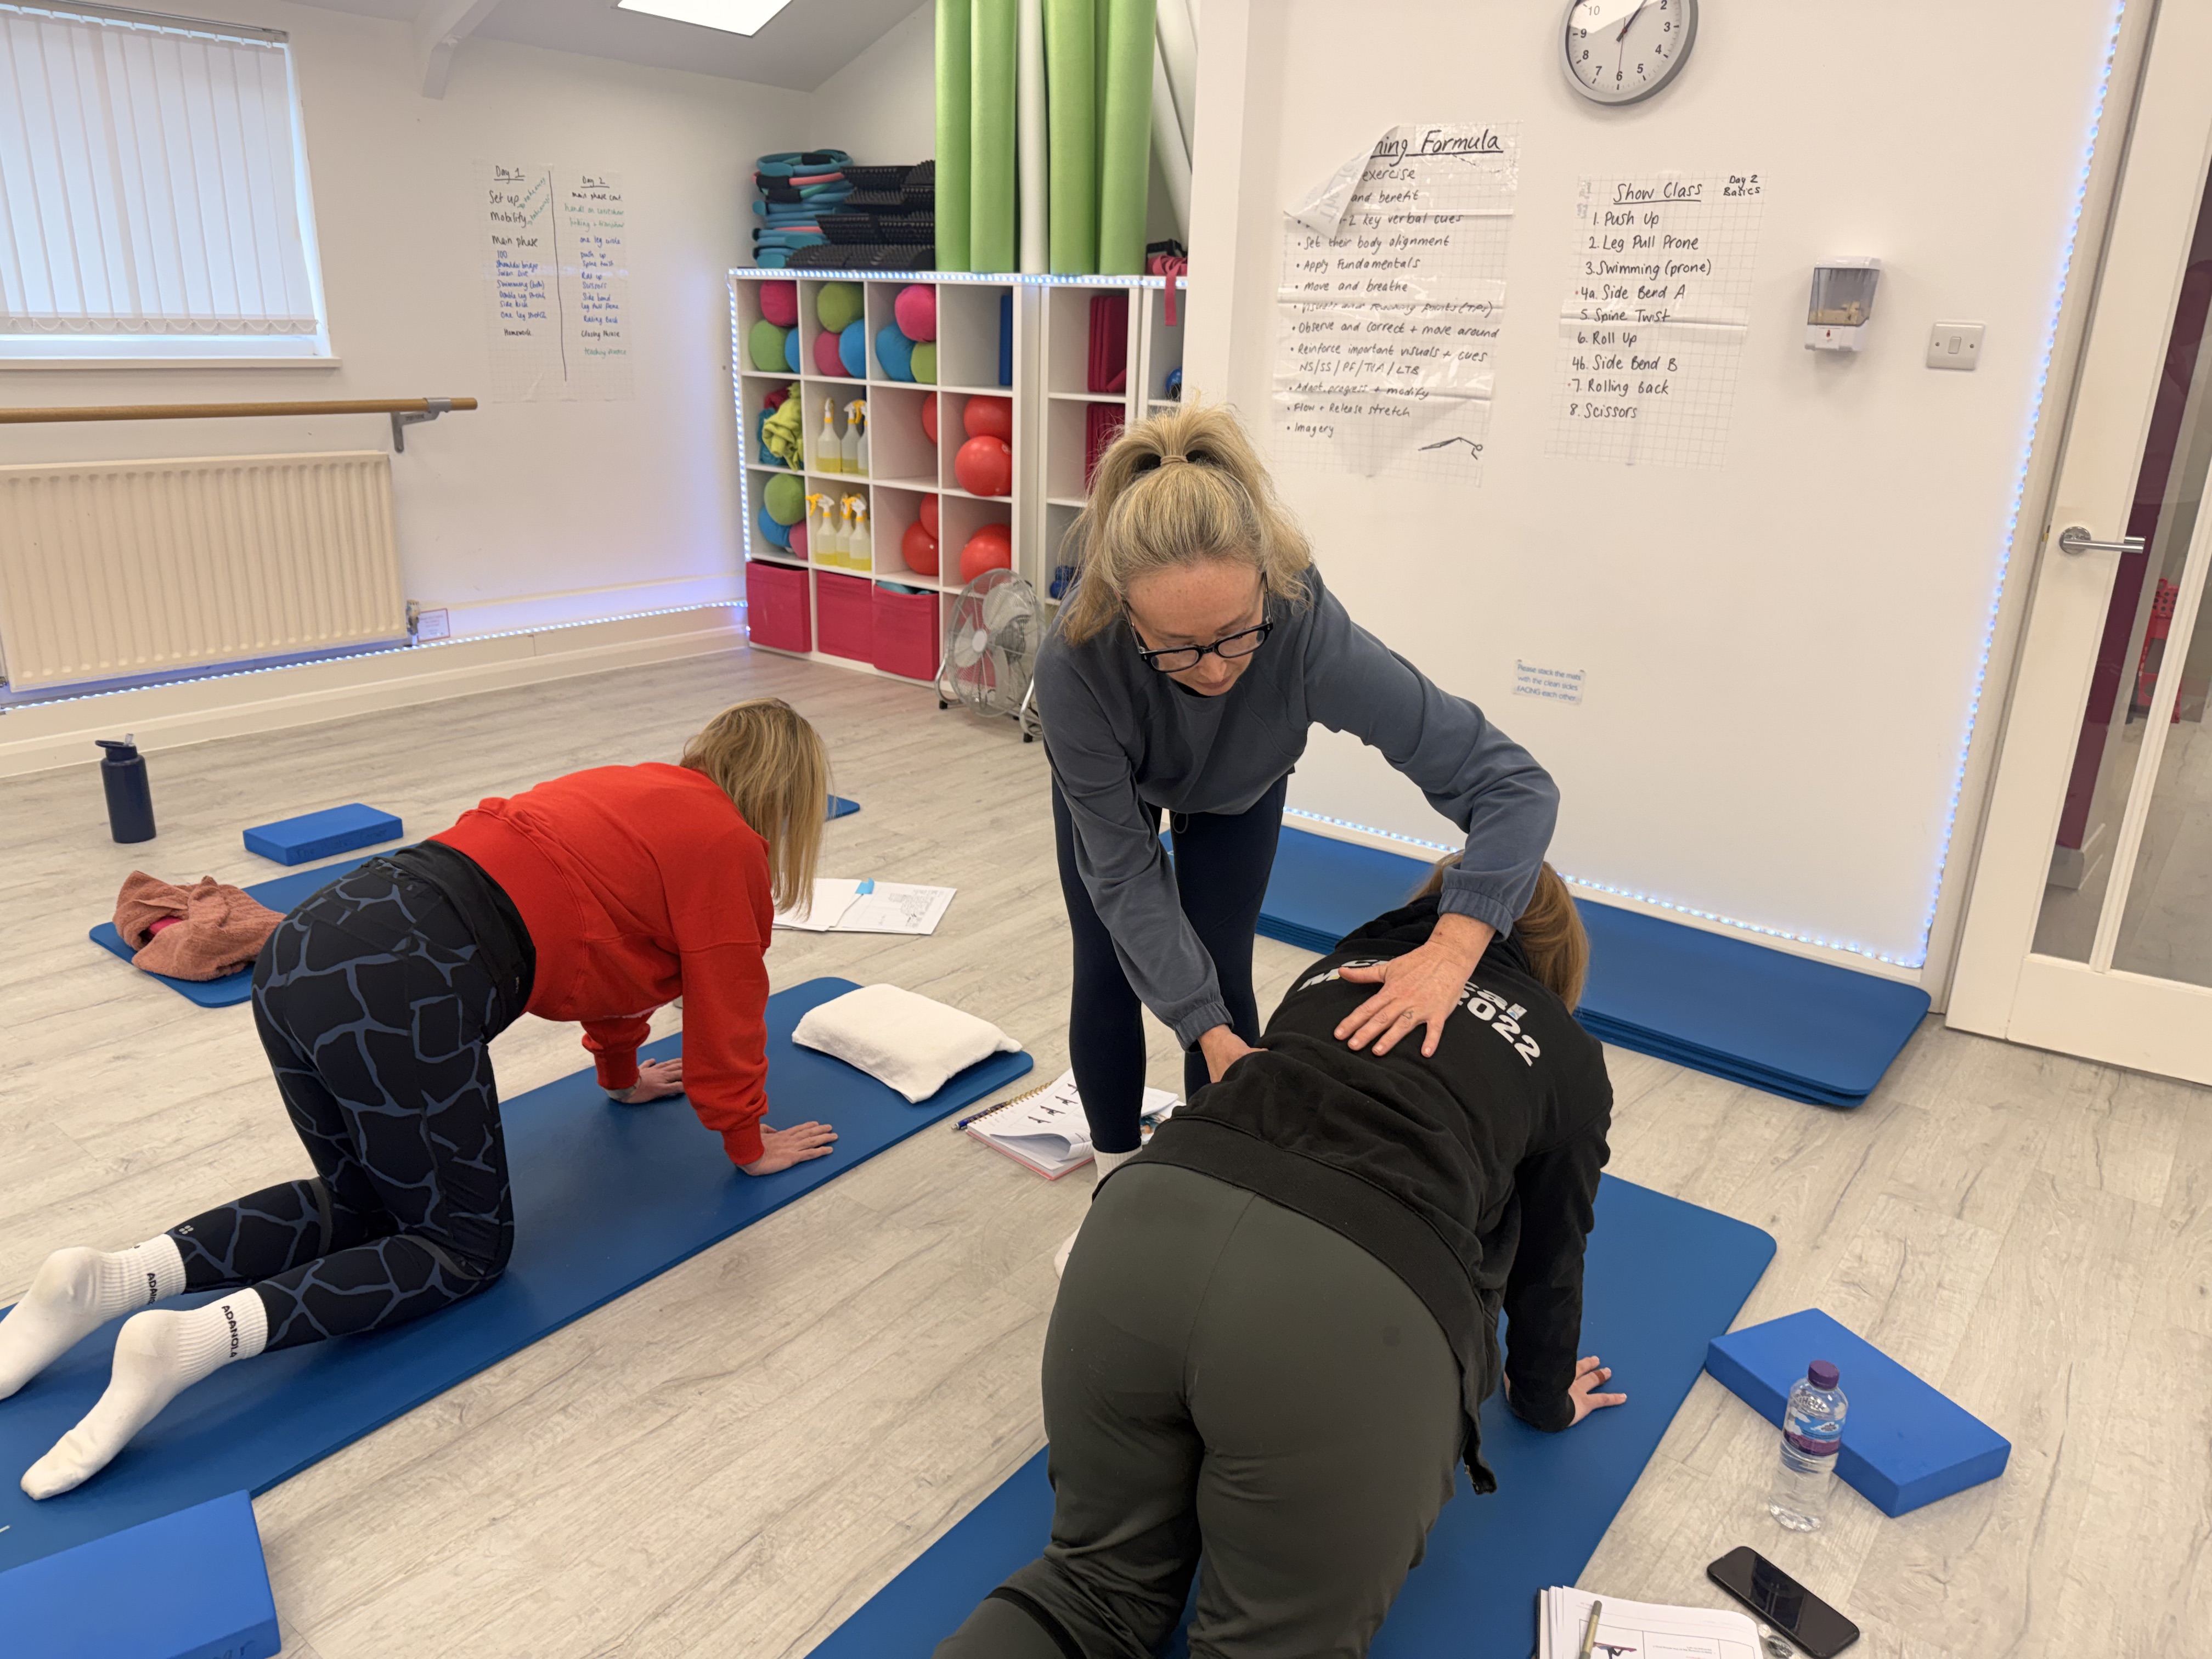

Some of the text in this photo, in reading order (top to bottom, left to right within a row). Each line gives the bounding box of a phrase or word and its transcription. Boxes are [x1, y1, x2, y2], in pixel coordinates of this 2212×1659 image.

[1588, 5, 1600, 15] 10
[1580, 29, 1587, 38] 9
[1664, 22, 1671, 32] 3
[1582, 50, 1589, 60] 8
[1655, 44, 1662, 54] 4
[1596, 66, 1602, 75] 7
[1616, 71, 1623, 81] 6
[1637, 64, 1644, 74] 5
[1421, 129, 1500, 153] Formula
[495, 165, 525, 184] Day 1
[582, 176, 595, 188] Day
[1362, 168, 1415, 182] exercise
[1729, 174, 1758, 187] Day 2
[489, 190, 503, 204] Set
[507, 195, 519, 206] up
[1351, 190, 1419, 203] and benefit
[1613, 183, 1654, 203] Show
[1664, 182, 1702, 198] Class
[1723, 186, 1760, 196] Basics
[490, 211, 527, 228] Mobility
[1363, 213, 1381, 229] key
[1388, 213, 1427, 224] verbal
[1434, 215, 1464, 224] cues
[1593, 211, 1659, 227] 1. Push Up
[1304, 234, 1450, 255] Set their body alignment
[1589, 235, 1699, 253] 2. Leg Pull Prone
[497, 250, 508, 259] 100
[1304, 258, 1329, 274] Apply
[1585, 258, 1712, 281] 3. Swimming (prone)
[1338, 280, 1358, 291] and
[1366, 279, 1408, 292] breathe
[1603, 284, 1629, 301] Side
[1638, 285, 1666, 300] Bend
[1674, 284, 1685, 300] A
[1594, 308, 1628, 323] Spine
[1635, 308, 1671, 322] Twist
[1299, 321, 1335, 334] Observe
[1341, 322, 1361, 332] and
[1458, 328, 1500, 339] around
[1578, 331, 1638, 347] 6. Roll Up
[1298, 343, 1341, 356] Reinforce
[1348, 344, 1394, 356] important
[1401, 346, 1440, 358] visuals
[1458, 352, 1488, 362] cues
[1592, 354, 1624, 371] Side
[1631, 357, 1660, 371] Bend
[1667, 358, 1678, 373] B
[1386, 387, 1430, 400] modify
[1571, 379, 1582, 392] 7.
[1588, 377, 1629, 397] Rolling
[1294, 403, 1314, 413] Flow
[1329, 404, 1362, 415] Release
[1368, 404, 1410, 417] stretch
[1570, 402, 1638, 419] 8. Scissors
[1294, 422, 1334, 437] Imagery
[221, 1305, 240, 1358] ADANOLA
